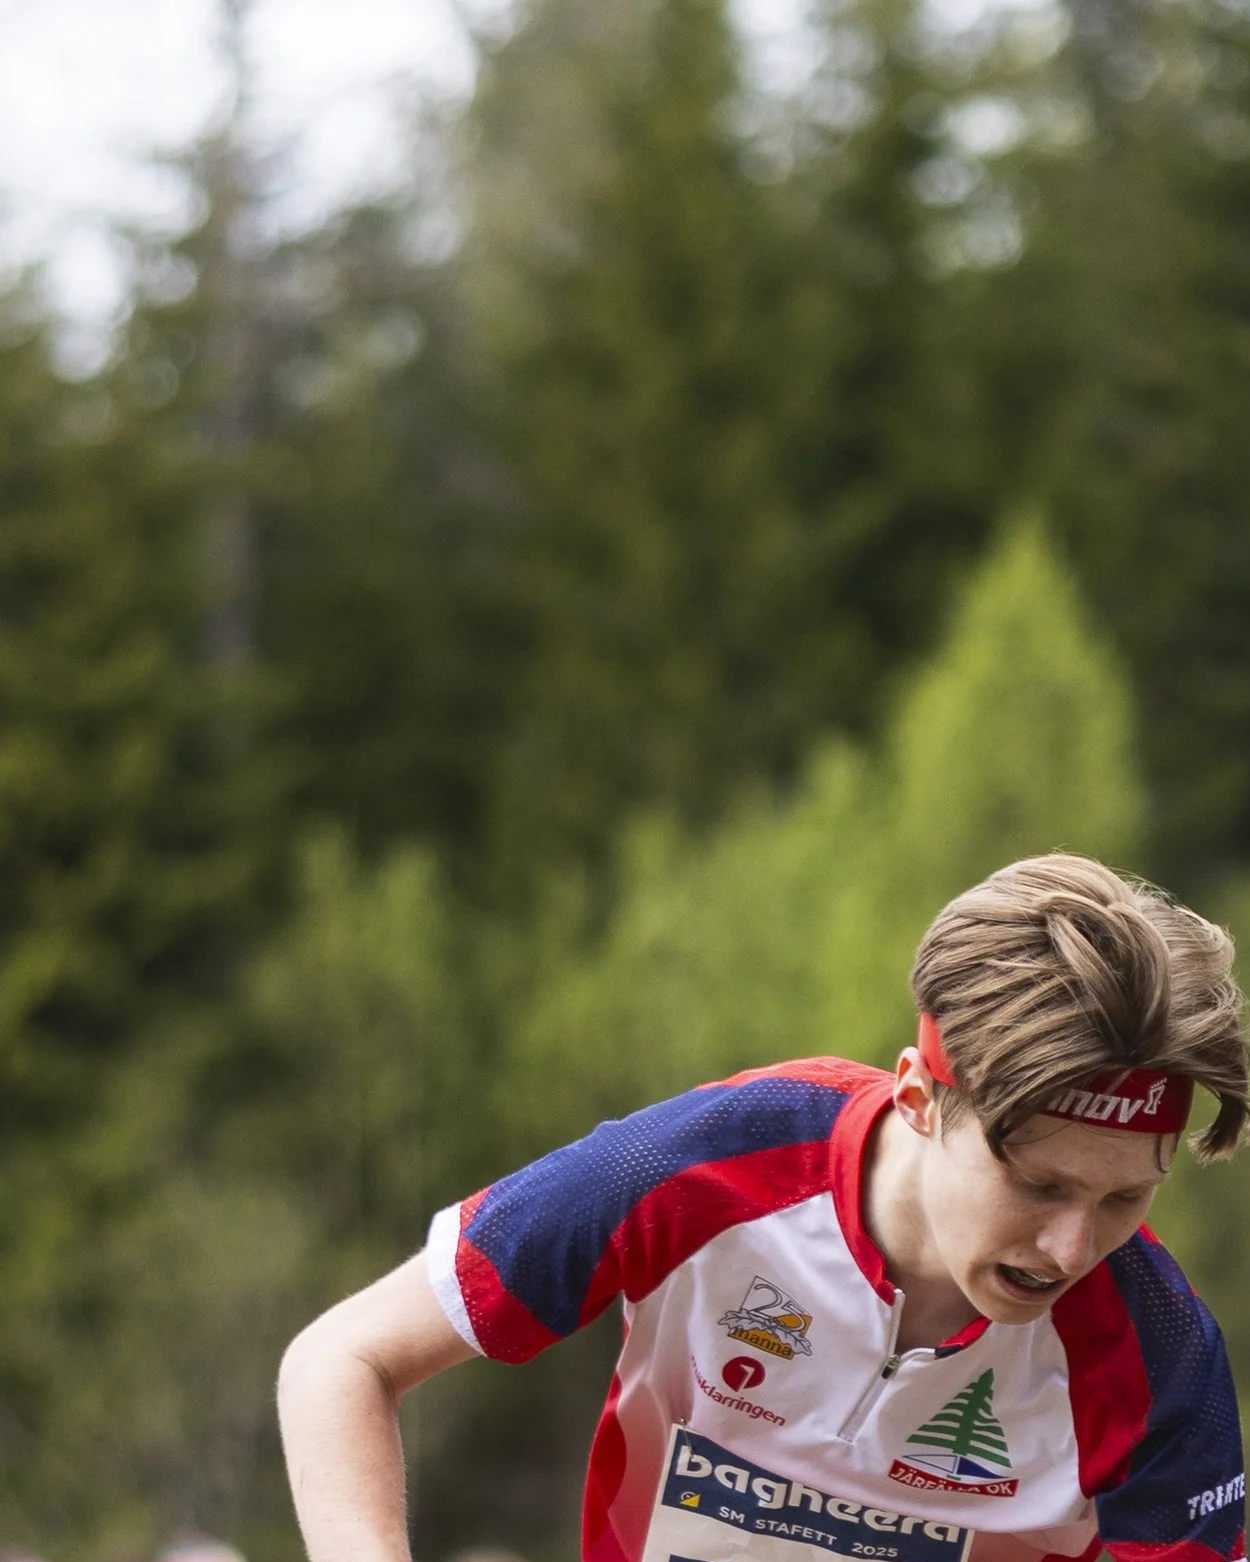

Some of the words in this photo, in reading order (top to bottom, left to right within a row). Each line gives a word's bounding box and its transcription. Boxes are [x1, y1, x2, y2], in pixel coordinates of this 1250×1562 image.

[675, 1445, 960, 1544] bagheera
[985, 1481, 1014, 1496] OK
[718, 1505, 746, 1524] SM
[755, 1518, 837, 1547] STAFETT
[851, 1541, 899, 1558] 2025
